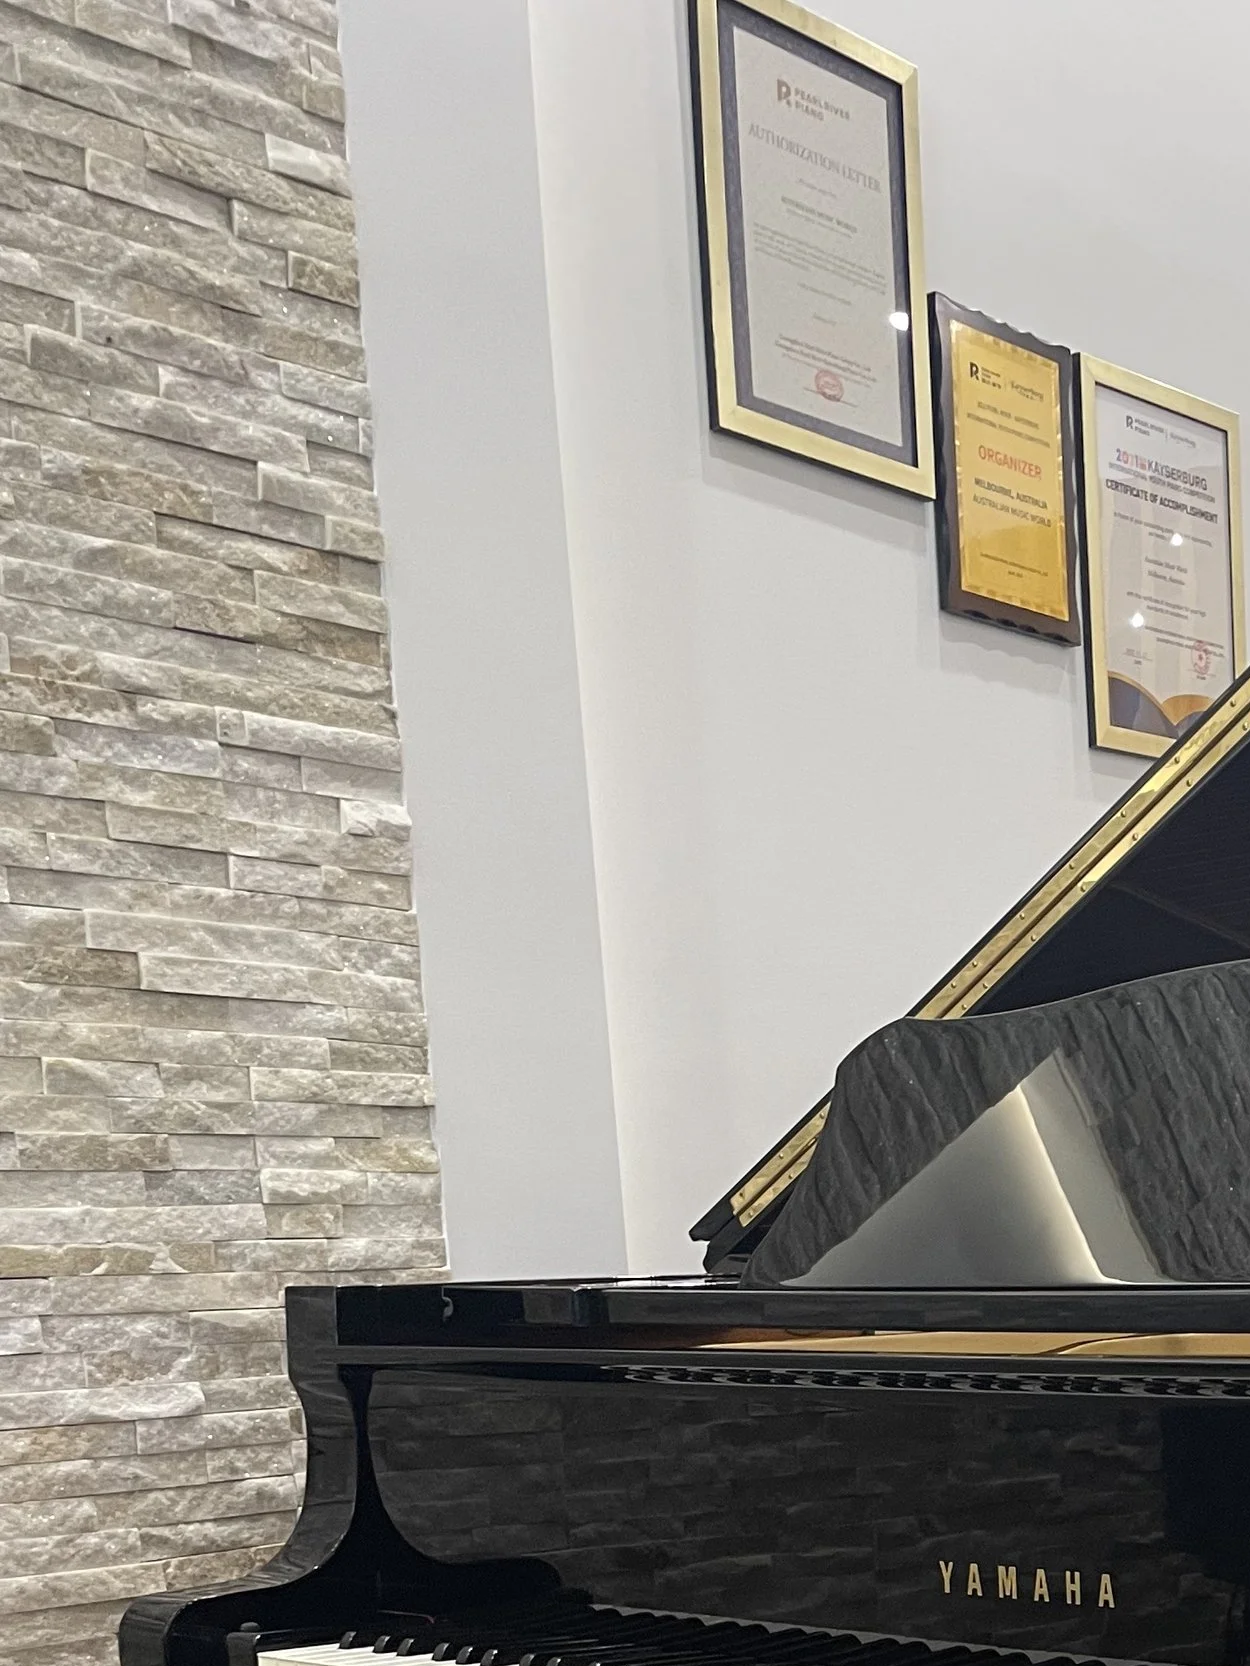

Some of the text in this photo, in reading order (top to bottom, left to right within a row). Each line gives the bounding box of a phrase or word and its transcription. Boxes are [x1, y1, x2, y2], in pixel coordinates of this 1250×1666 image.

[748, 123, 840, 174] AUTHORIZATION
[842, 164, 882, 194] LETTER
[978, 445, 1042, 480] ORGANIZER
[1147, 459, 1208, 491] KAYSERBURG
[1105, 479, 1149, 502] CERTIFICATE
[1149, 492, 1159, 504] OF
[938, 1560, 1115, 1609] YAMAHA
